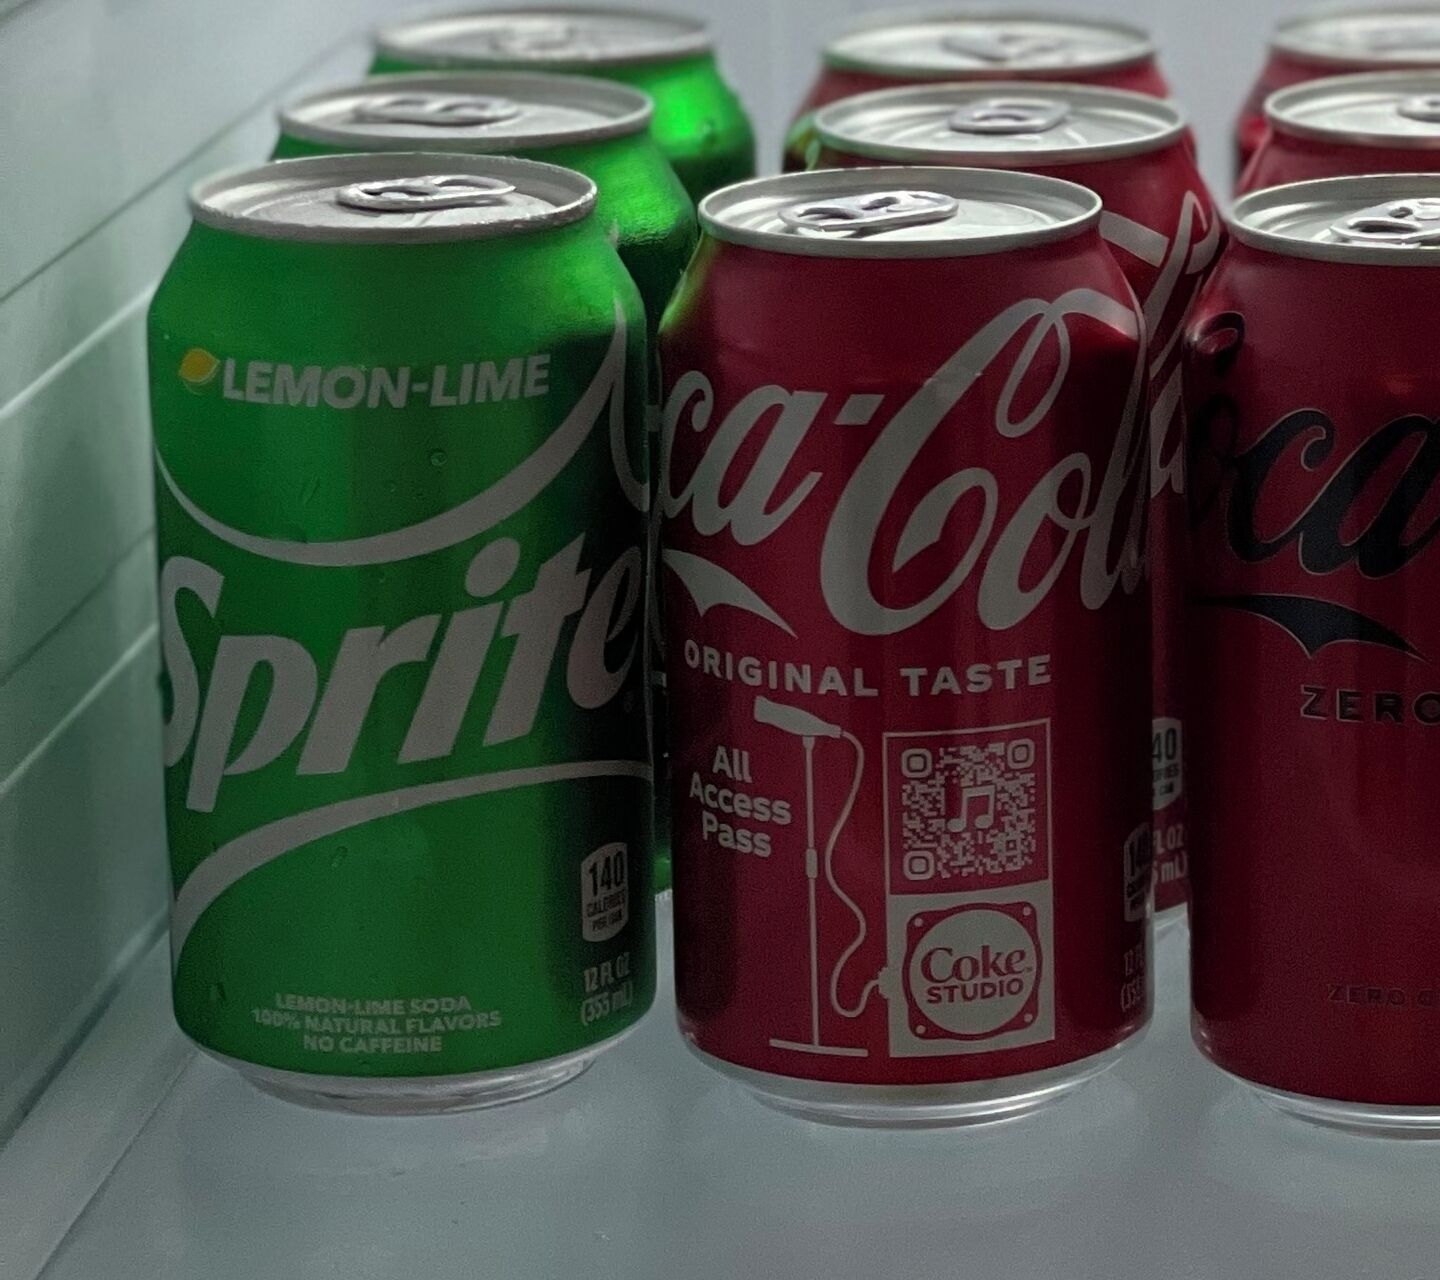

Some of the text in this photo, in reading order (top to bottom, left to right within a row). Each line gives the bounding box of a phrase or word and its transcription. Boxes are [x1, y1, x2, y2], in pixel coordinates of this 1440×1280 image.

[222, 354, 551, 409] LEMON-LIME
[161, 532, 641, 813] Sprite
[684, 638, 1052, 697] ORIGINAL TASTE
[712, 744, 753, 784] All
[1152, 727, 1177, 763] 40
[689, 770, 793, 826] Access
[702, 809, 772, 858] Pass
[589, 850, 624, 897] 140
[921, 944, 1027, 984] Coke
[275, 992, 472, 1016] LEMON-LIME SODA
[927, 978, 1024, 1004] STUDIO
[1328, 982, 1406, 1008] ZERO
[250, 1007, 501, 1034] 100% NATURAL FLAVORS
[303, 1035, 443, 1053] NO CAFFEINE
